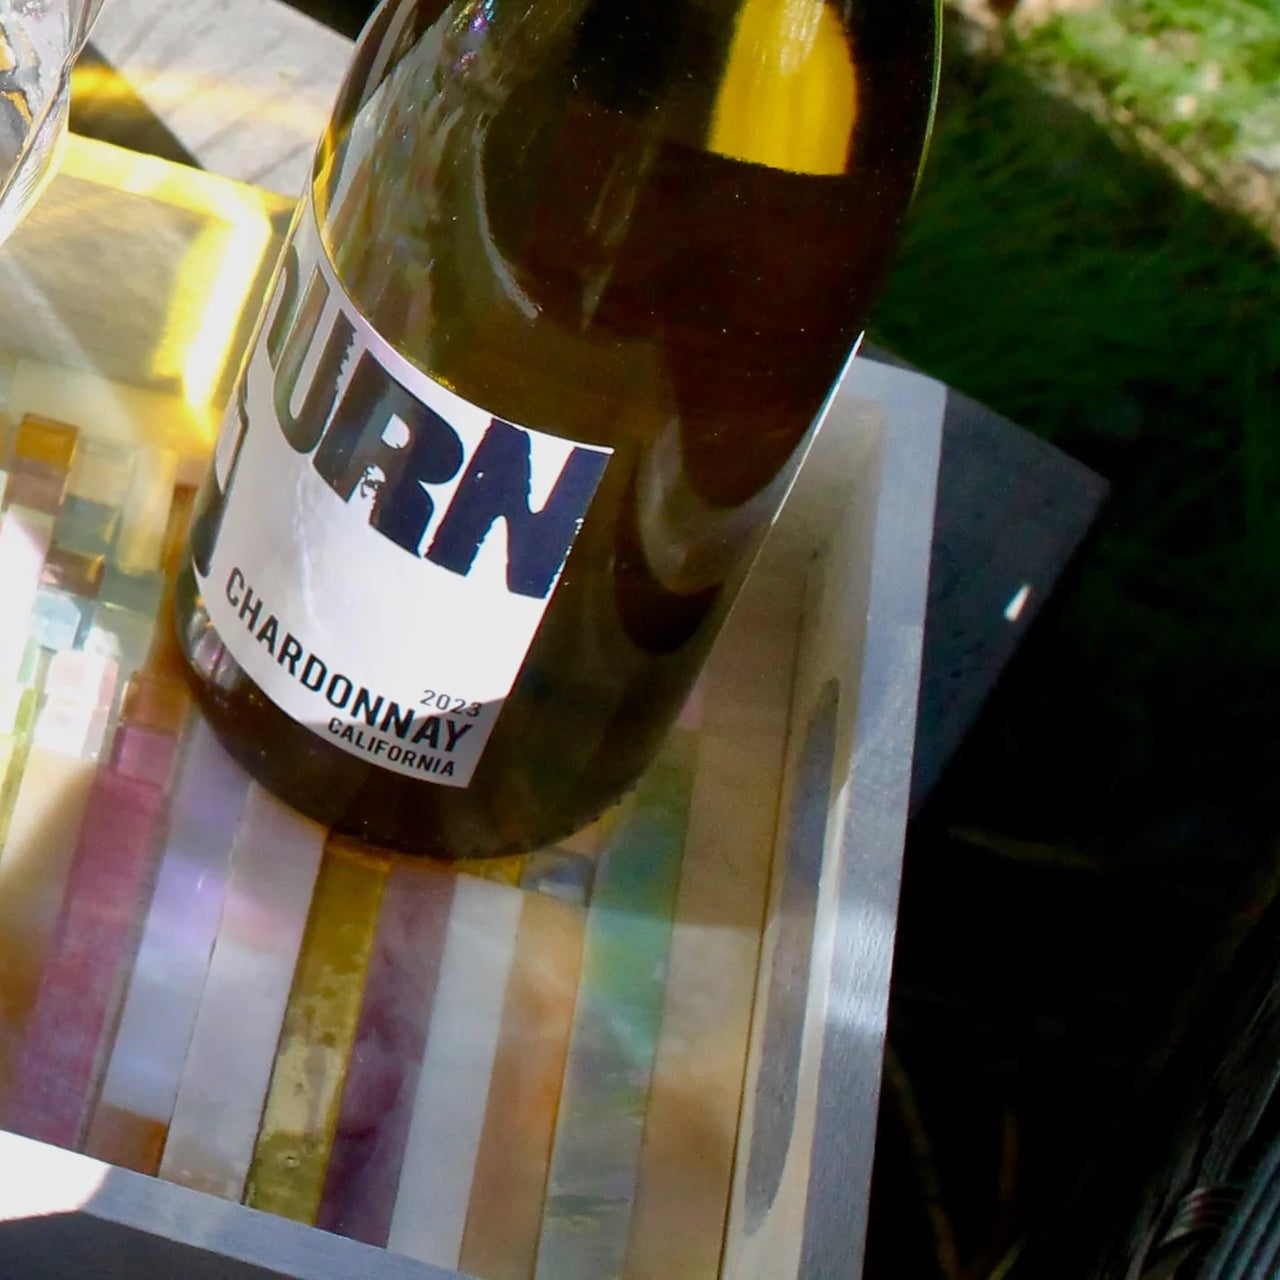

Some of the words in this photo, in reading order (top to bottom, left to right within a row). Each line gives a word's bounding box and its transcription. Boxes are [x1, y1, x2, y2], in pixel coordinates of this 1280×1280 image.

[266, 244, 613, 600] URN
[225, 567, 474, 753] CHARDONNAY
[420, 689, 482, 718] 2023
[328, 717, 455, 777] CALIFORNIA
